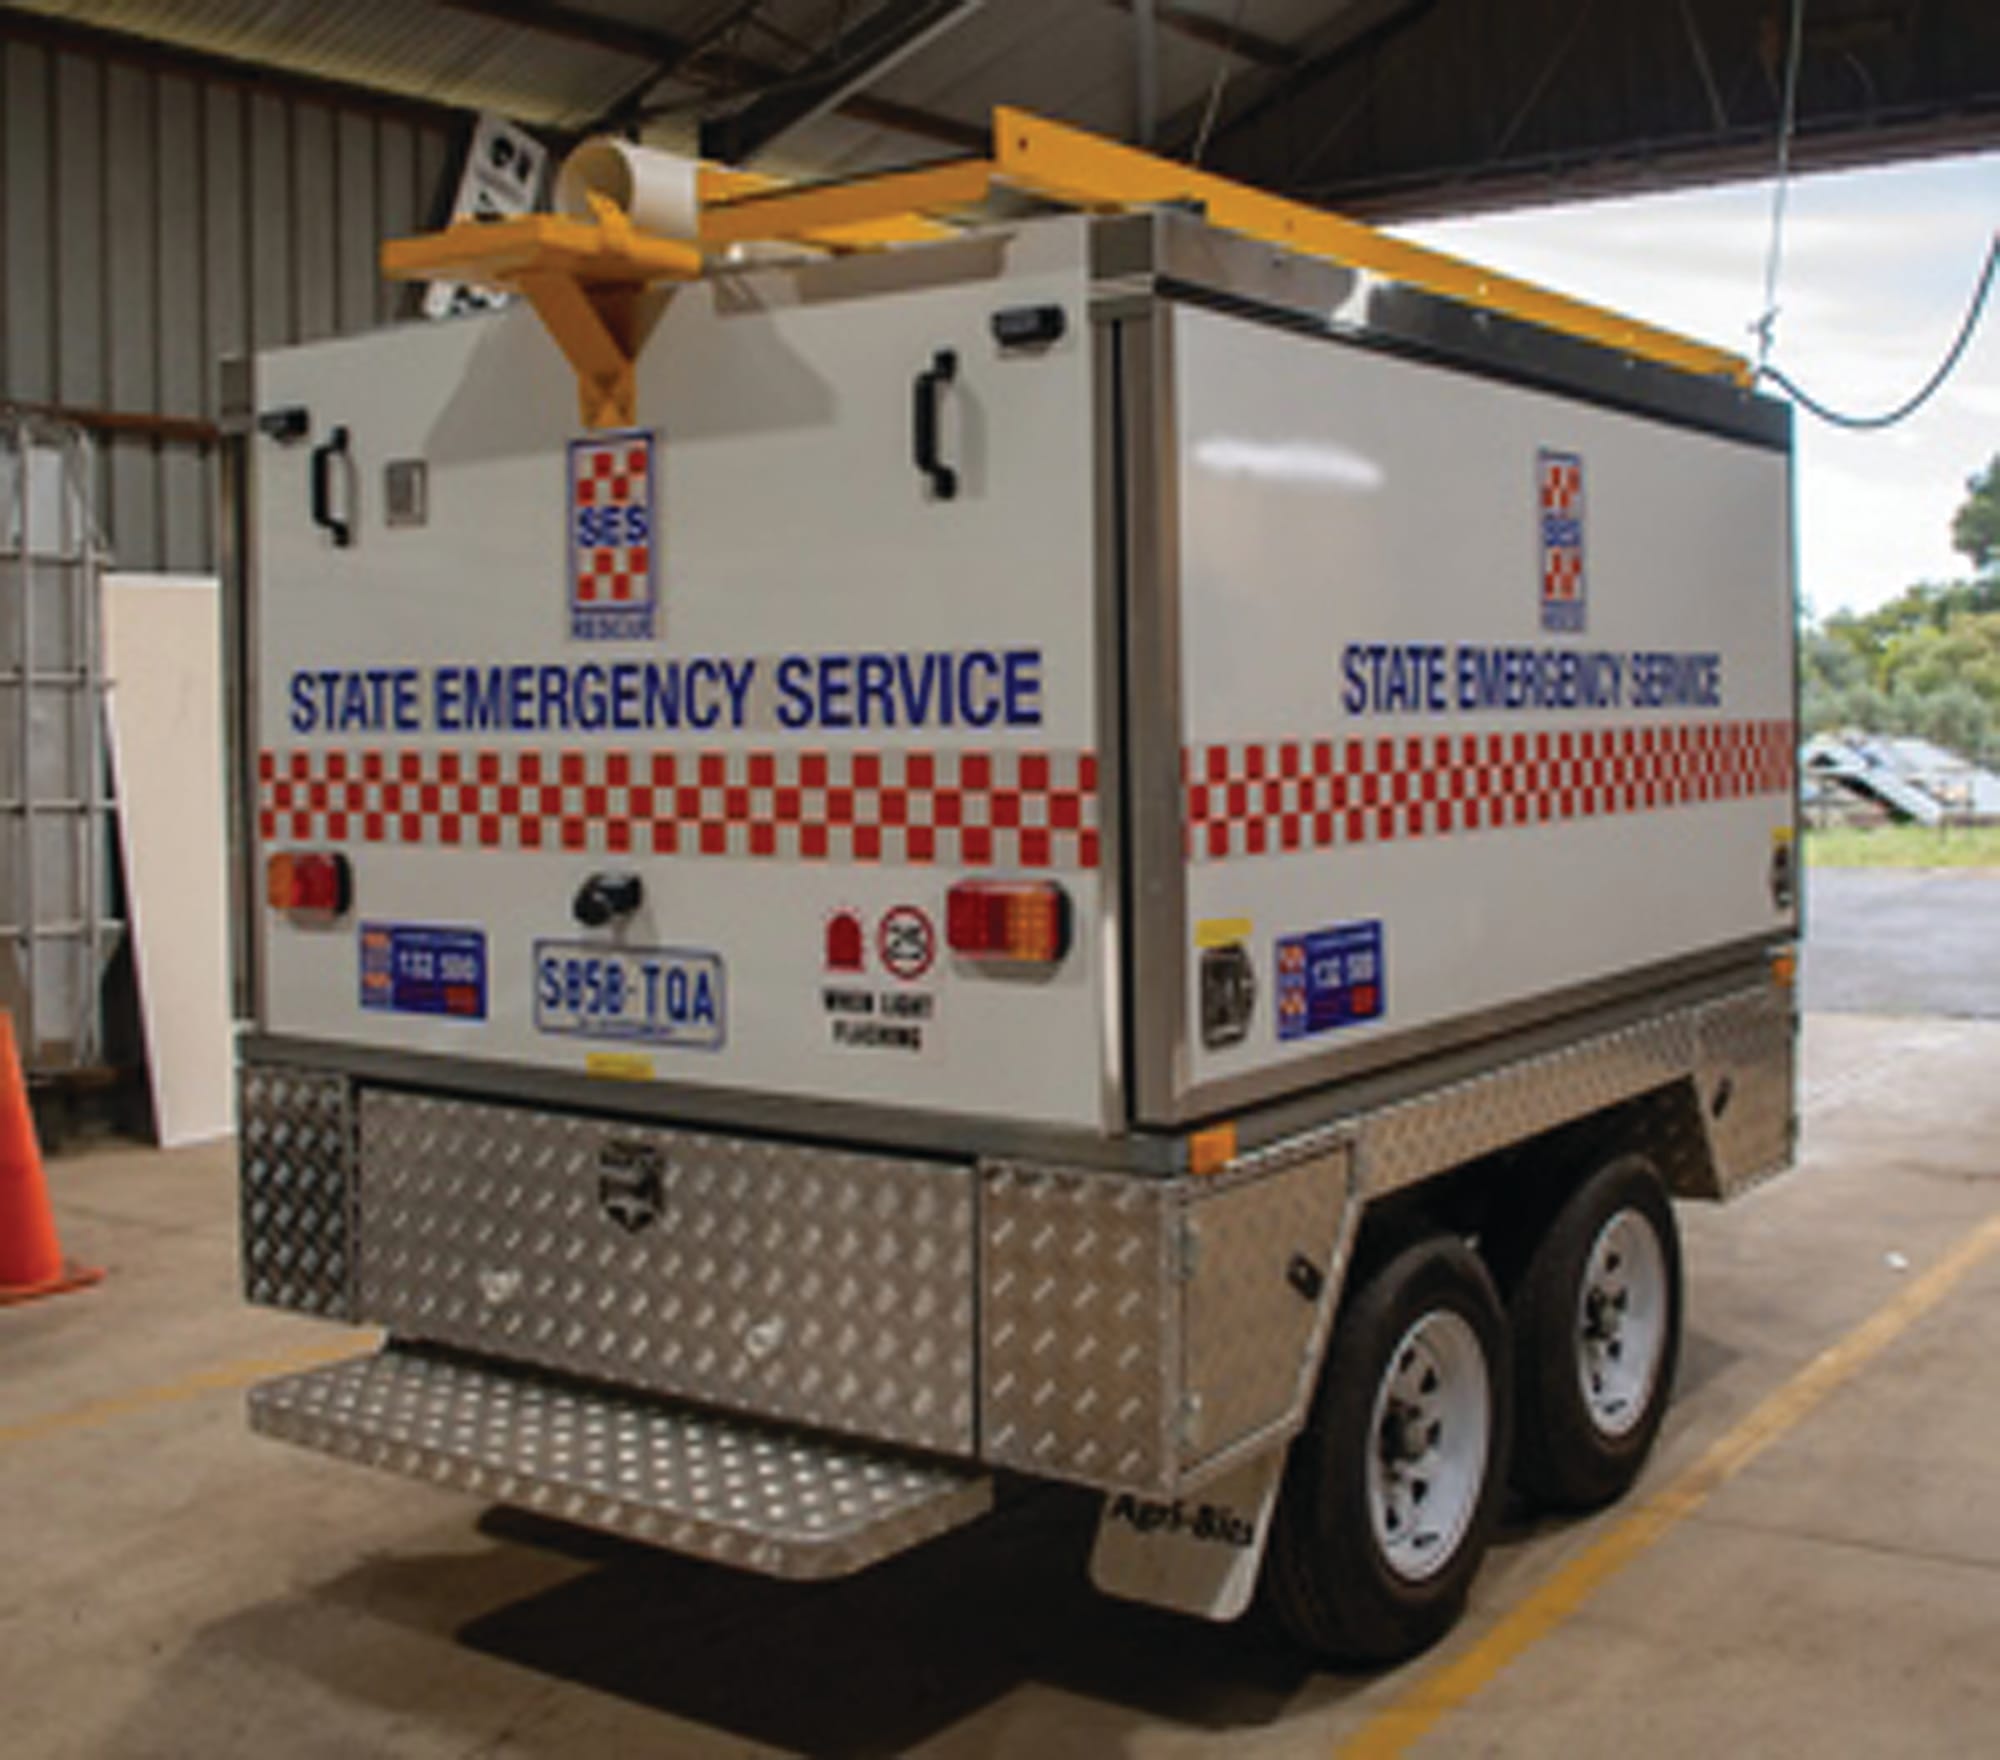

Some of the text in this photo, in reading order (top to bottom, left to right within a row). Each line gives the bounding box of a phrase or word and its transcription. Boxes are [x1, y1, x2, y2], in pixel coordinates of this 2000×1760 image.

[578, 504, 649, 548] SES
[290, 649, 1043, 733] STATE EMERGENCY SERVICE
[1342, 645, 1722, 715] STATE EMERGENCY SERVICE
[823, 989, 875, 1013] WHEN
